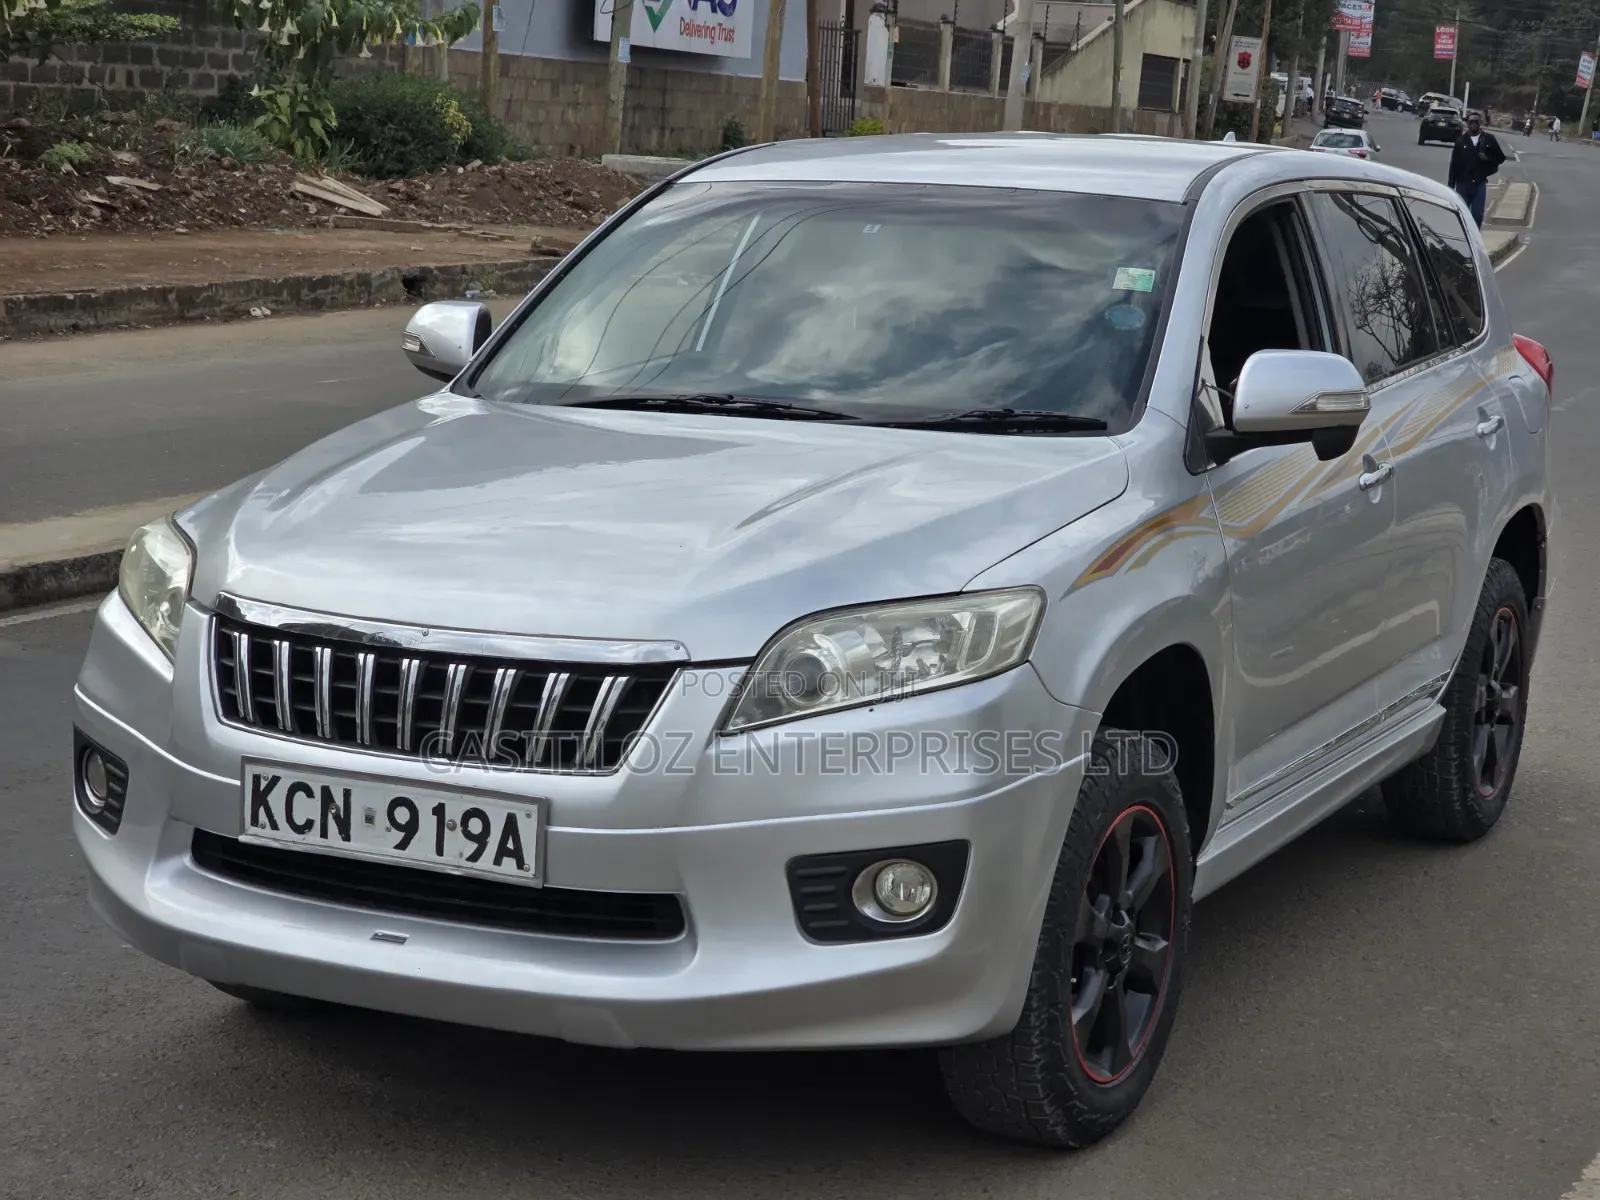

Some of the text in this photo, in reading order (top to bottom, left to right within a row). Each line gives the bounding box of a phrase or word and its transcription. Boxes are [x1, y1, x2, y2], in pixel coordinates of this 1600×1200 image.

[680, 16, 736, 45] Delivering Trust
[250, 773, 526, 871] KCN 919A
